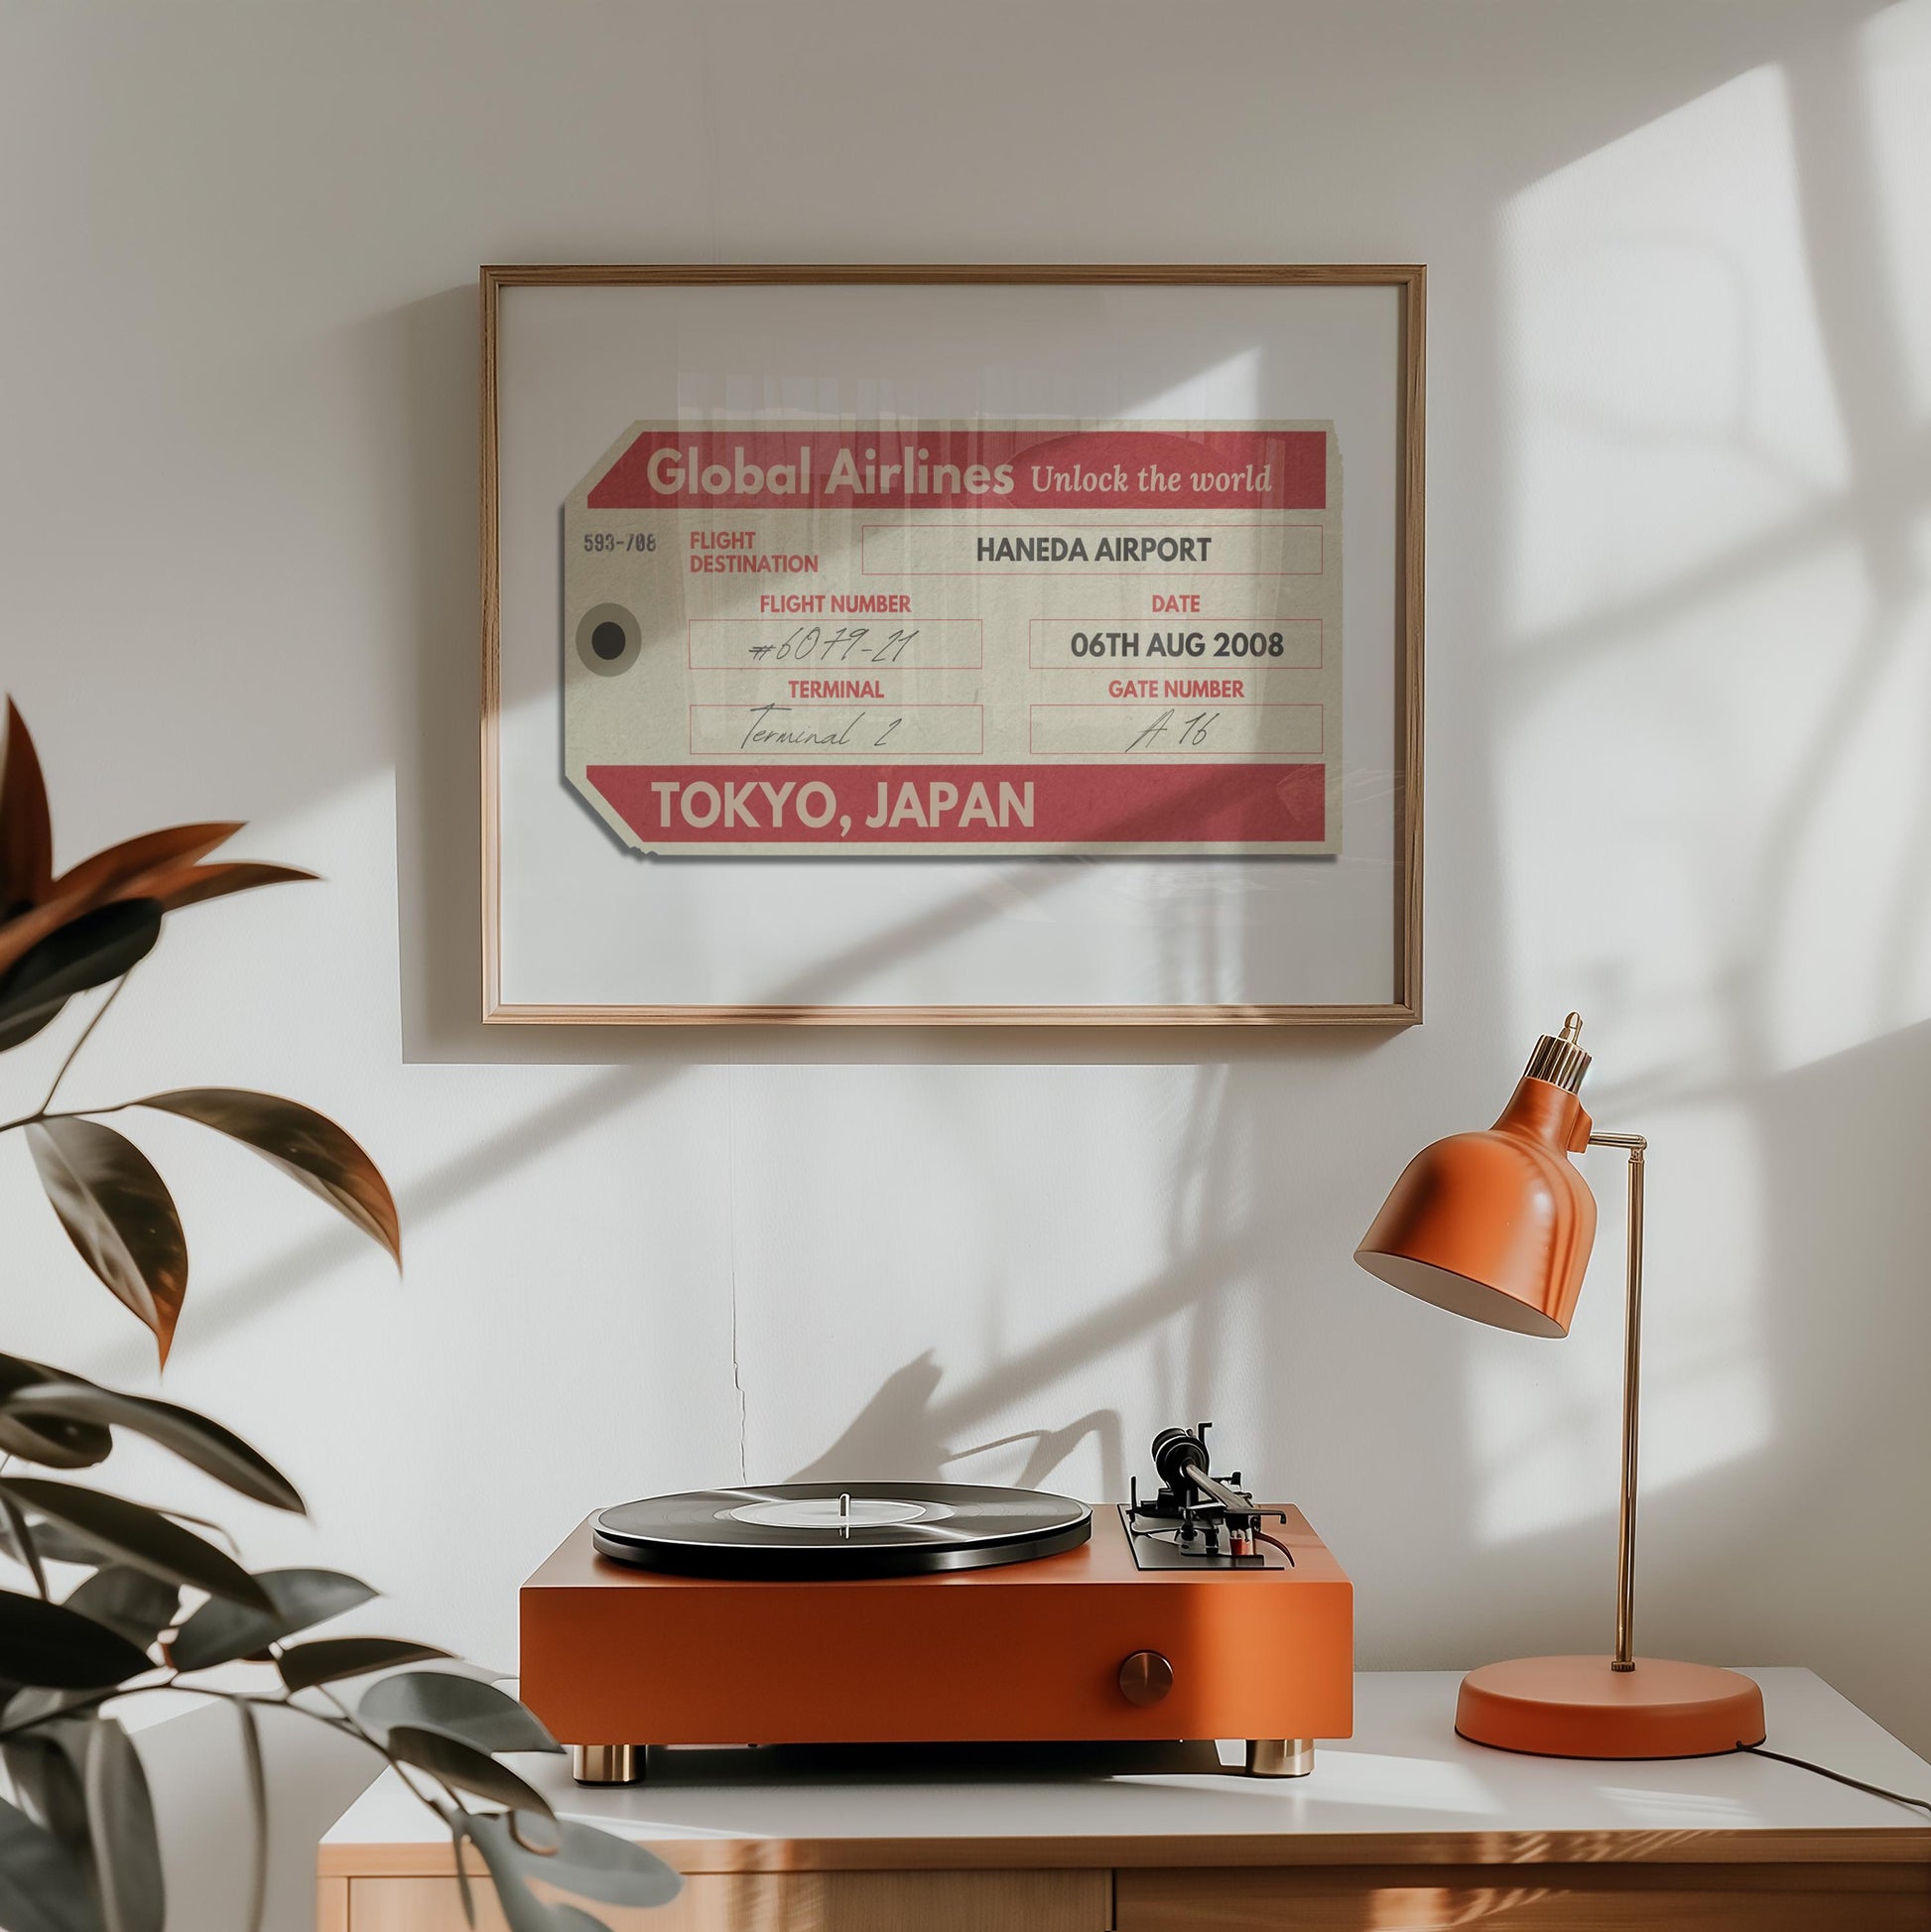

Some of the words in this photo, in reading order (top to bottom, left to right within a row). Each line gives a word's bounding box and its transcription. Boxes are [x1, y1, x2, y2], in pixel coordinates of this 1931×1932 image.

[647, 446, 811, 495] Global
[825, 446, 1014, 495] Airlines
[1031, 464, 1128, 492] Unlock
[1138, 464, 1181, 492] the
[1191, 464, 1272, 492] world
[583, 533, 657, 553] 593-708
[690, 531, 756, 550] FLIGHT
[976, 537, 1089, 562] HANEDA
[1094, 537, 1212, 562] AIRPORT
[690, 555, 819, 574] DESTINATION
[760, 595, 826, 613] FLIGHT
[832, 595, 911, 613] NUMBER
[1152, 595, 1201, 612] DATE
[1071, 632, 1139, 658] 06TH
[1146, 632, 1206, 658] AUG
[1214, 632, 1284, 658] 2008
[788, 681, 884, 699] TERMINAL
[1108, 680, 1159, 699] GATE
[1164, 680, 1245, 699] NUMBER
[741, 703, 865, 749] Terminal
[874, 717, 902, 746] 2
[1124, 708, 1175, 753] A
[651, 781, 852, 837] TOKYO,
[865, 781, 1035, 828] JAPAN
